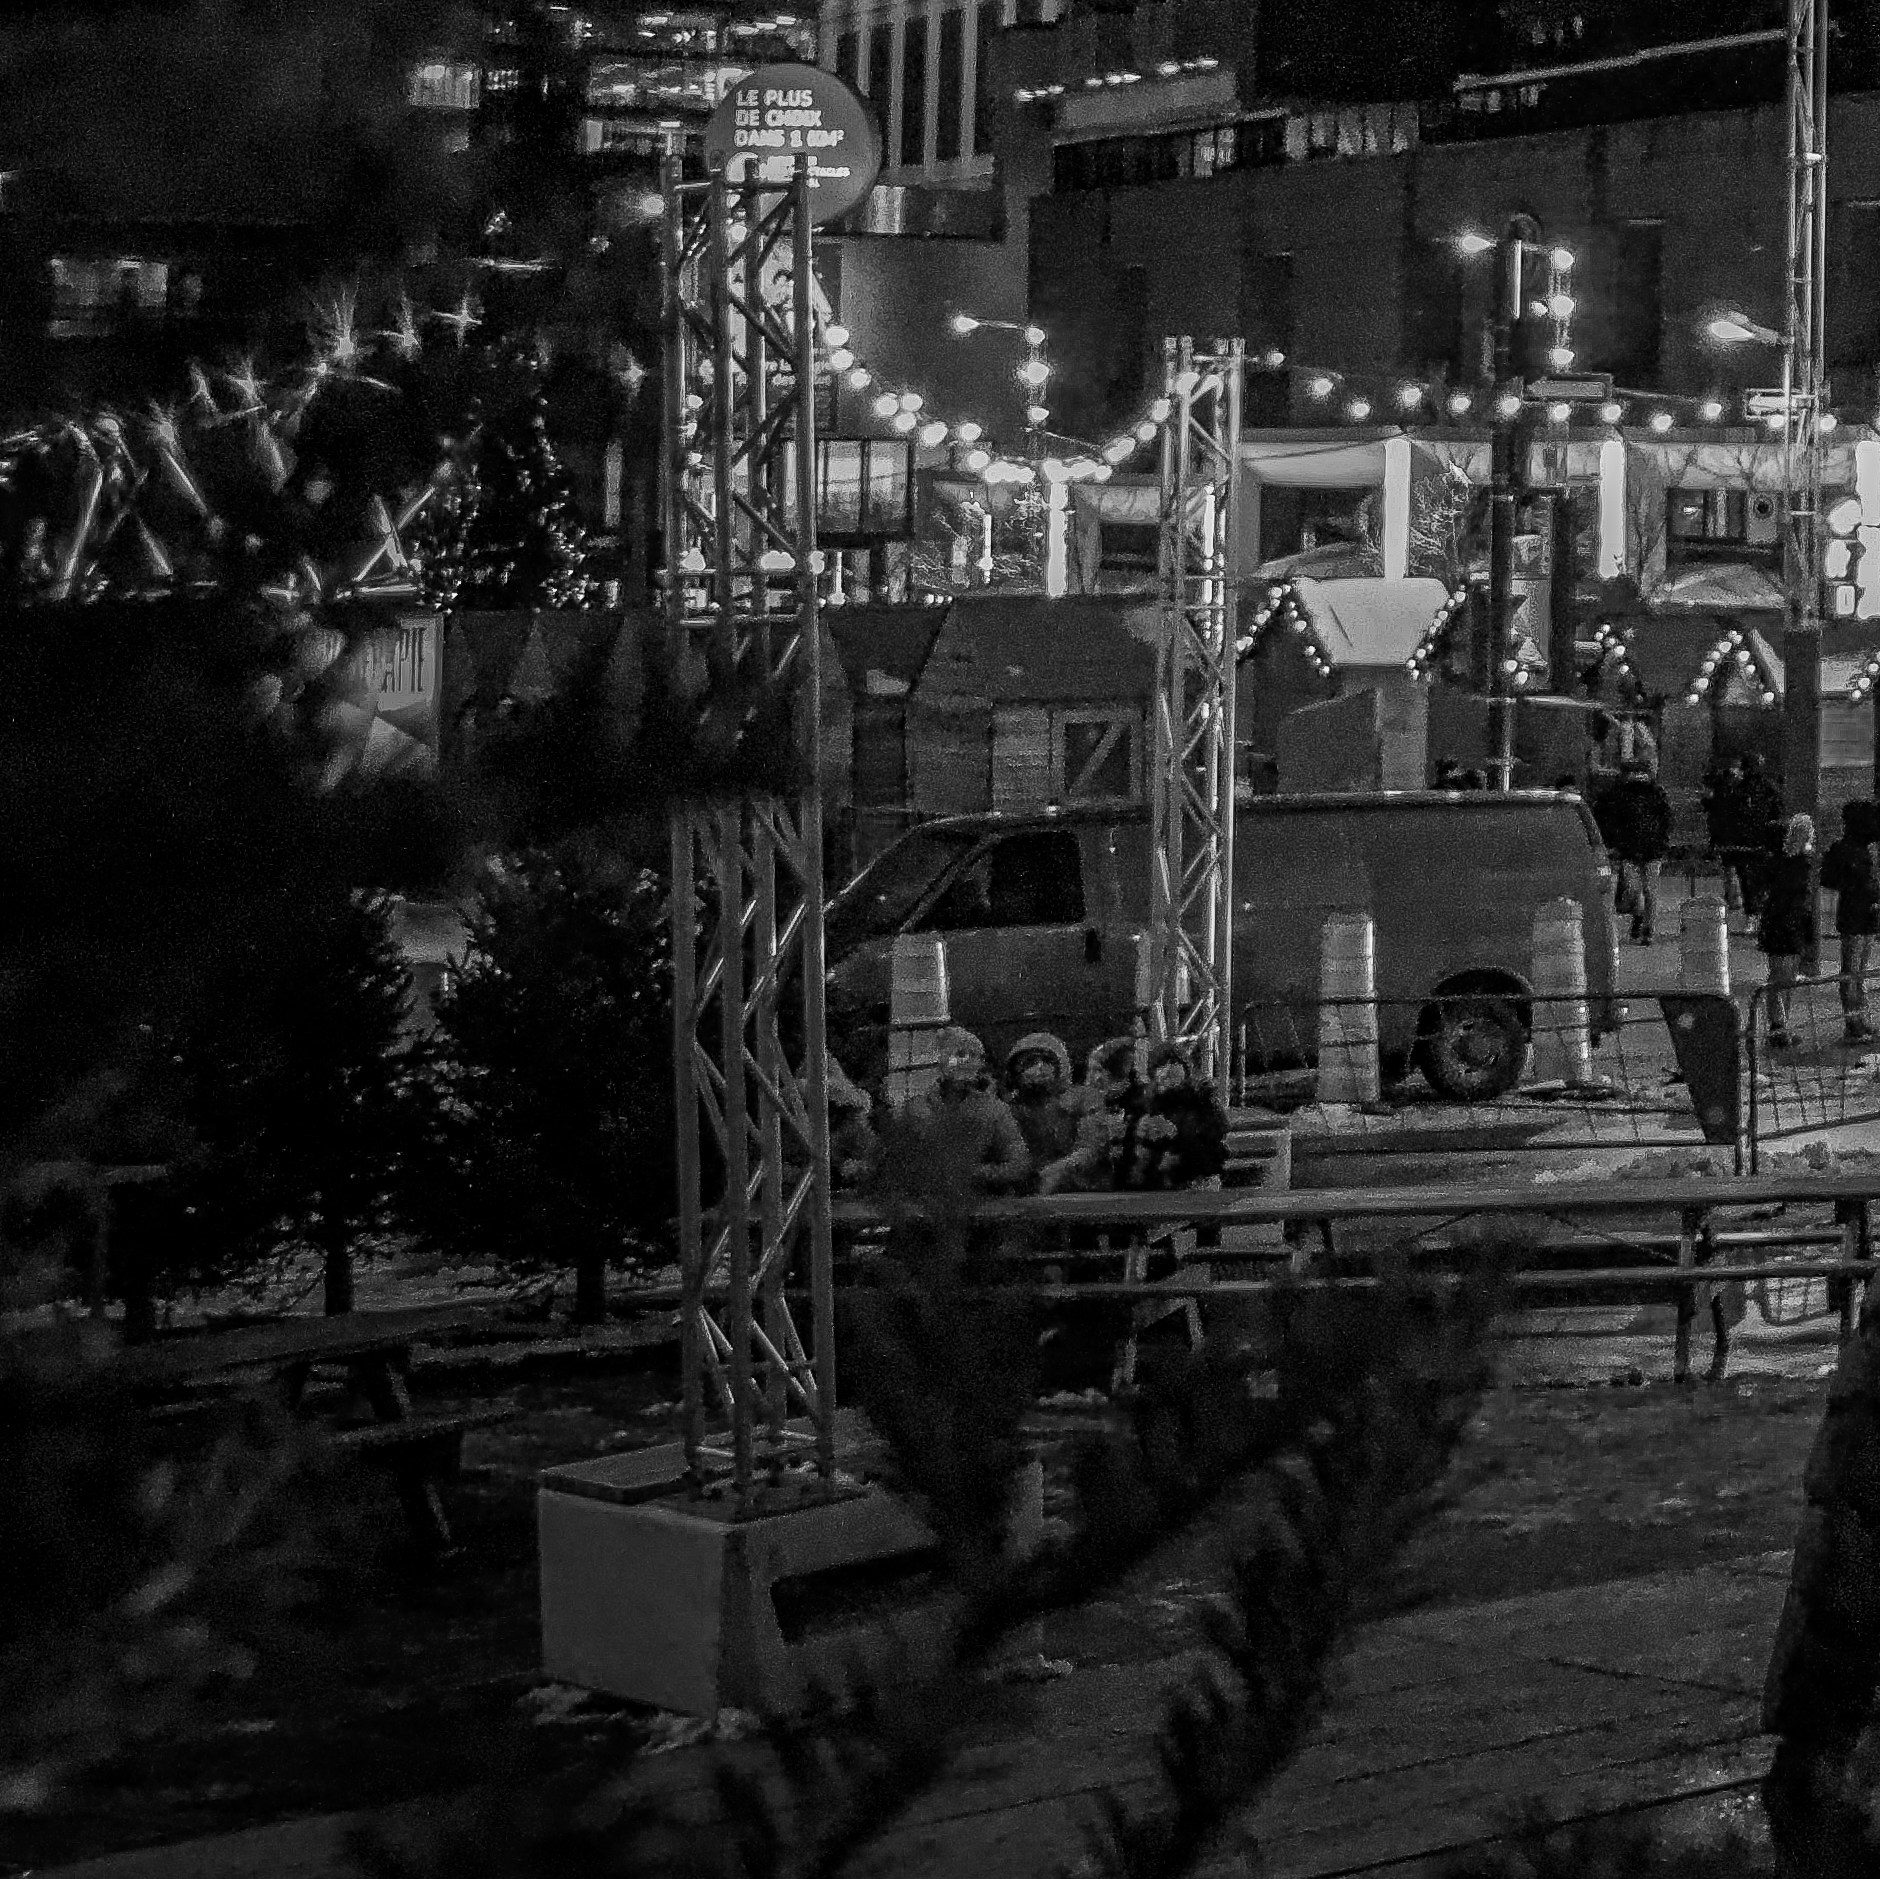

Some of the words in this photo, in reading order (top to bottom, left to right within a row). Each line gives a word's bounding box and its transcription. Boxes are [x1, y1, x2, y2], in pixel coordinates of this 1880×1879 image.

[736, 89, 759, 106] LE
[763, 89, 813, 107] PLUS
[735, 109, 760, 126] DE
[734, 129, 785, 147] DANS
